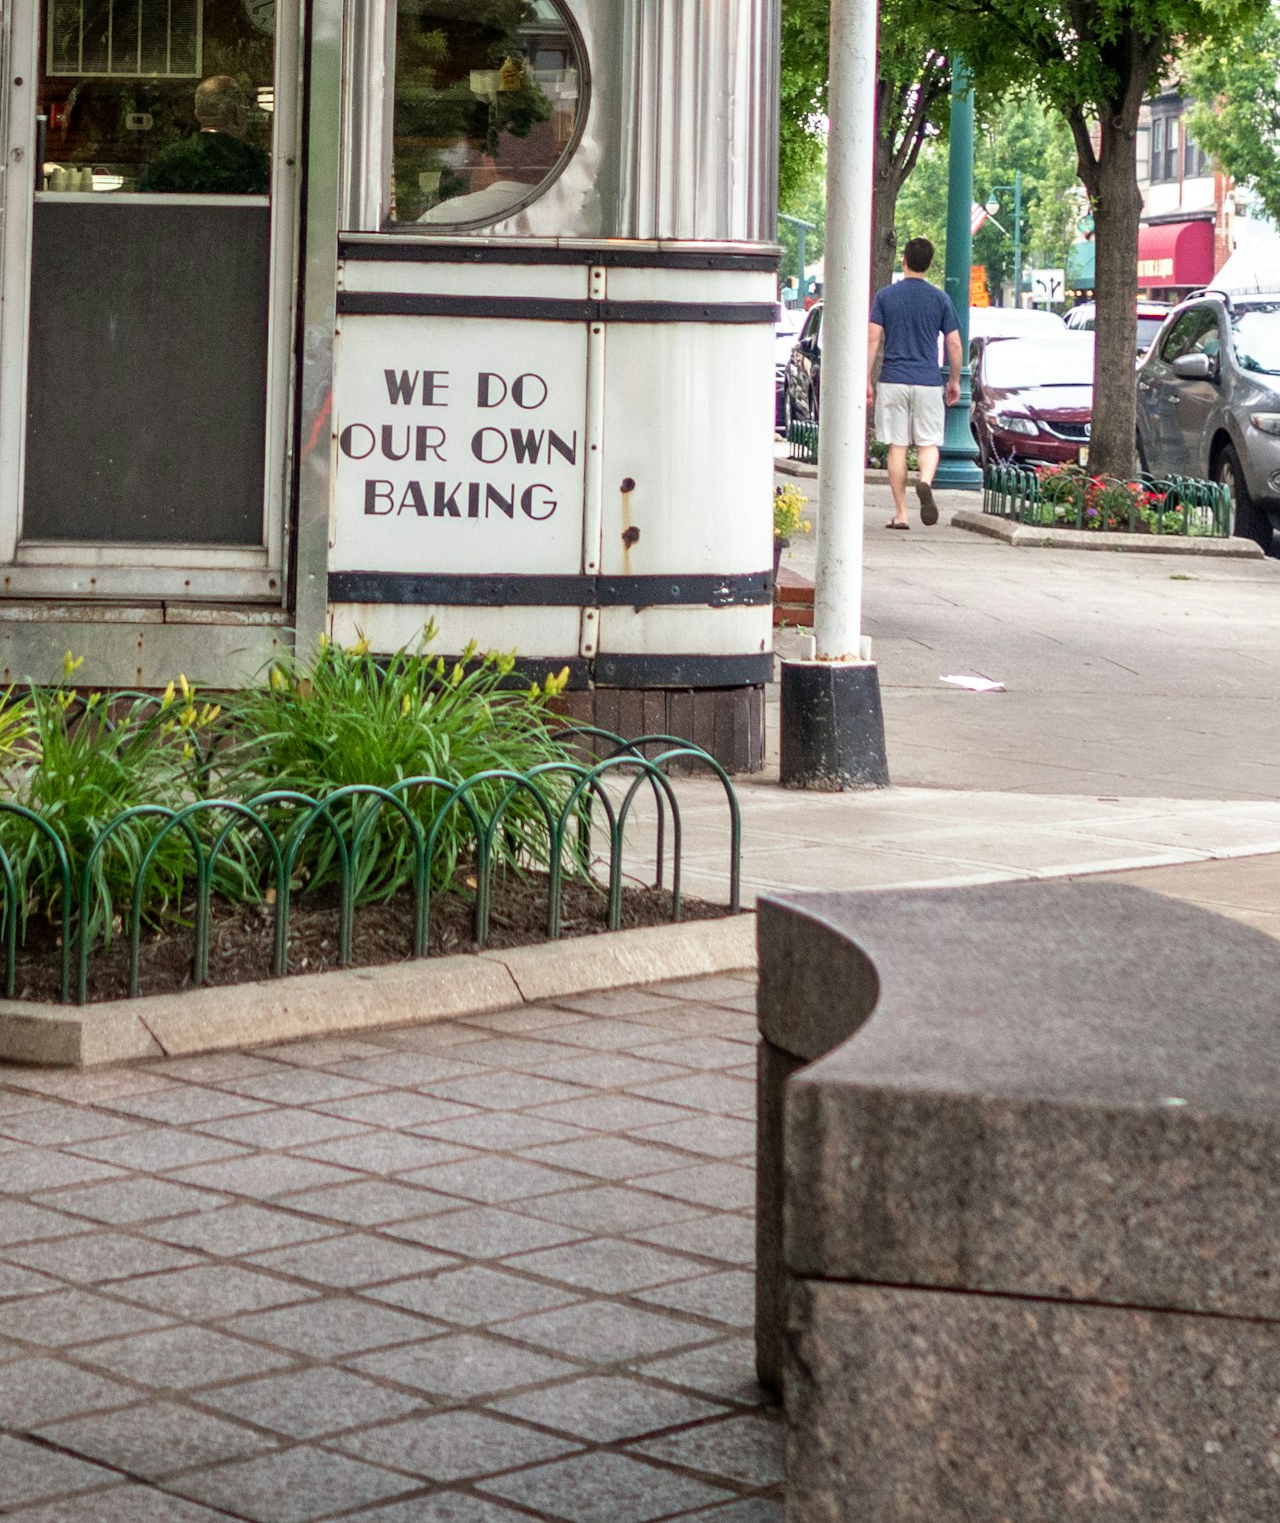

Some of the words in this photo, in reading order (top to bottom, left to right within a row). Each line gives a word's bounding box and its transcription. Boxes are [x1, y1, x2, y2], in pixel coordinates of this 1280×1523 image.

[384, 369, 449, 407] WE
[476, 372, 548, 410] DO
[339, 423, 447, 462] OUR
[471, 426, 577, 466] OWN
[363, 479, 558, 521] BAKING
